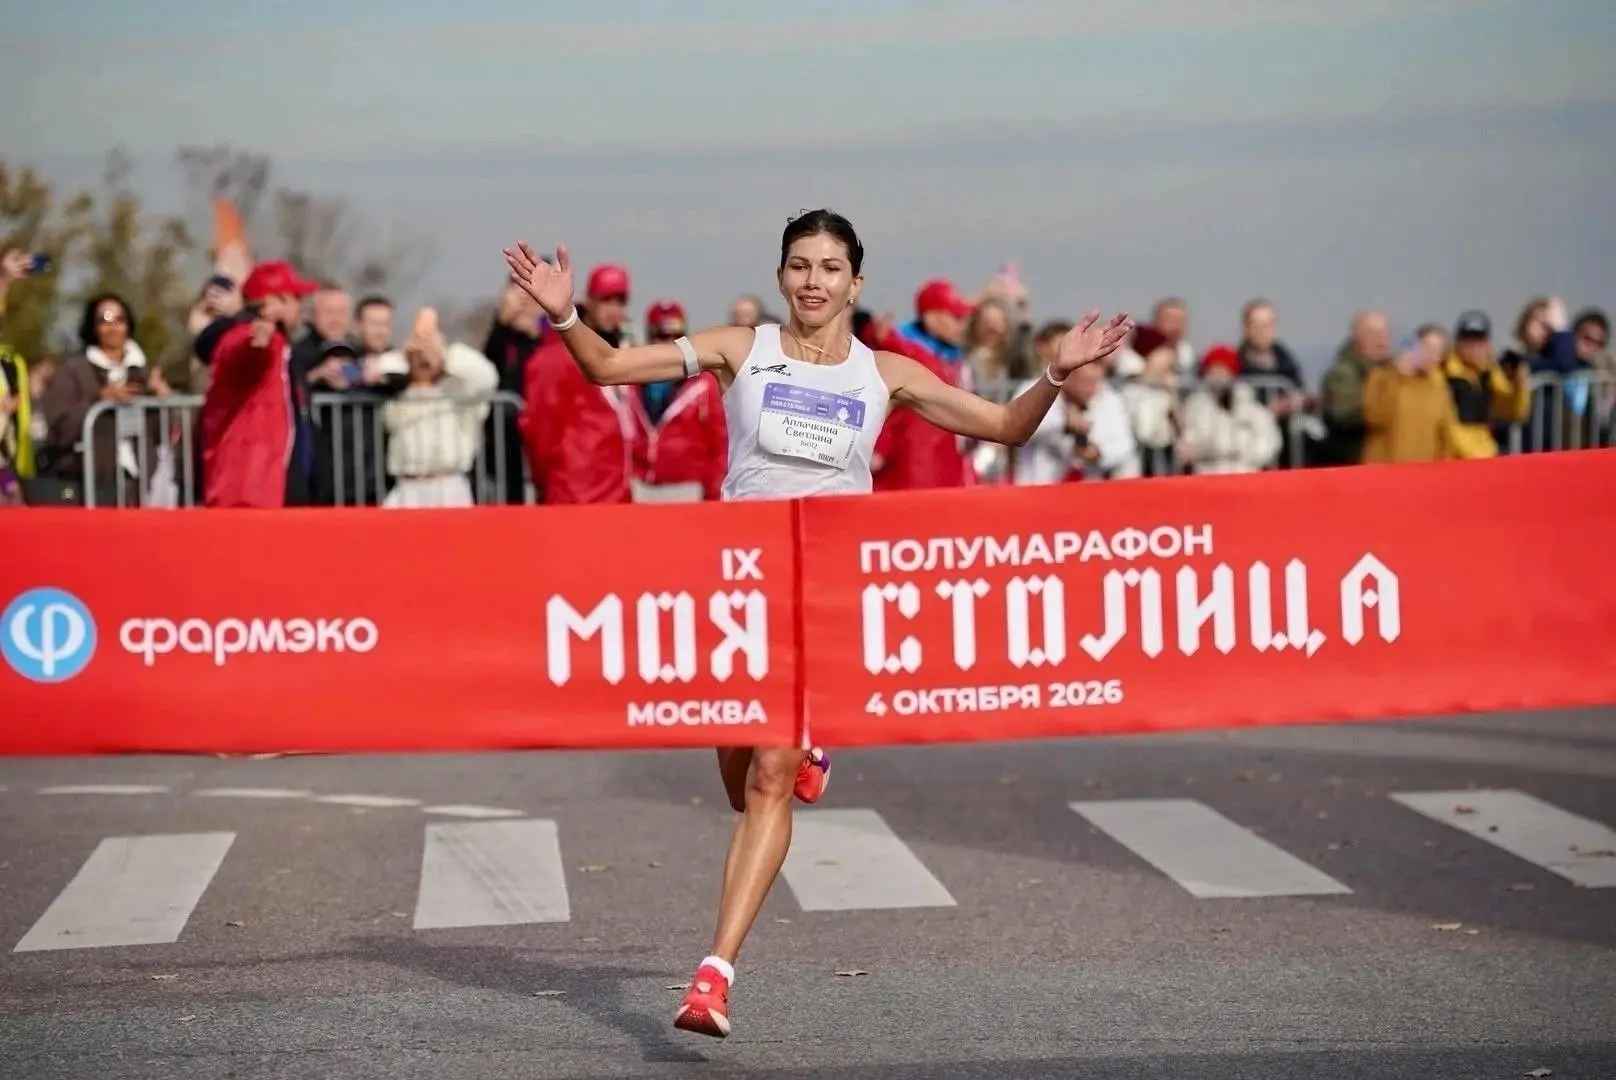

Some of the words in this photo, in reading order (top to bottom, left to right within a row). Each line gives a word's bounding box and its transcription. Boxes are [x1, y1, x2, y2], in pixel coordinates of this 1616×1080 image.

[782, 417, 838, 436] Аплачкина
[785, 427, 833, 445] Светлана
[721, 549, 763, 580] IX
[860, 524, 1213, 573] ПОЛУМАРАФОН
[546, 590, 769, 685] МОЯ
[861, 553, 1401, 675] СТОЛИЦА
[627, 700, 768, 726] МОСКВА
[865, 692, 887, 716] 4
[892, 685, 1041, 715] ОКТЯБРЯ
[1048, 679, 1124, 707] 2026
